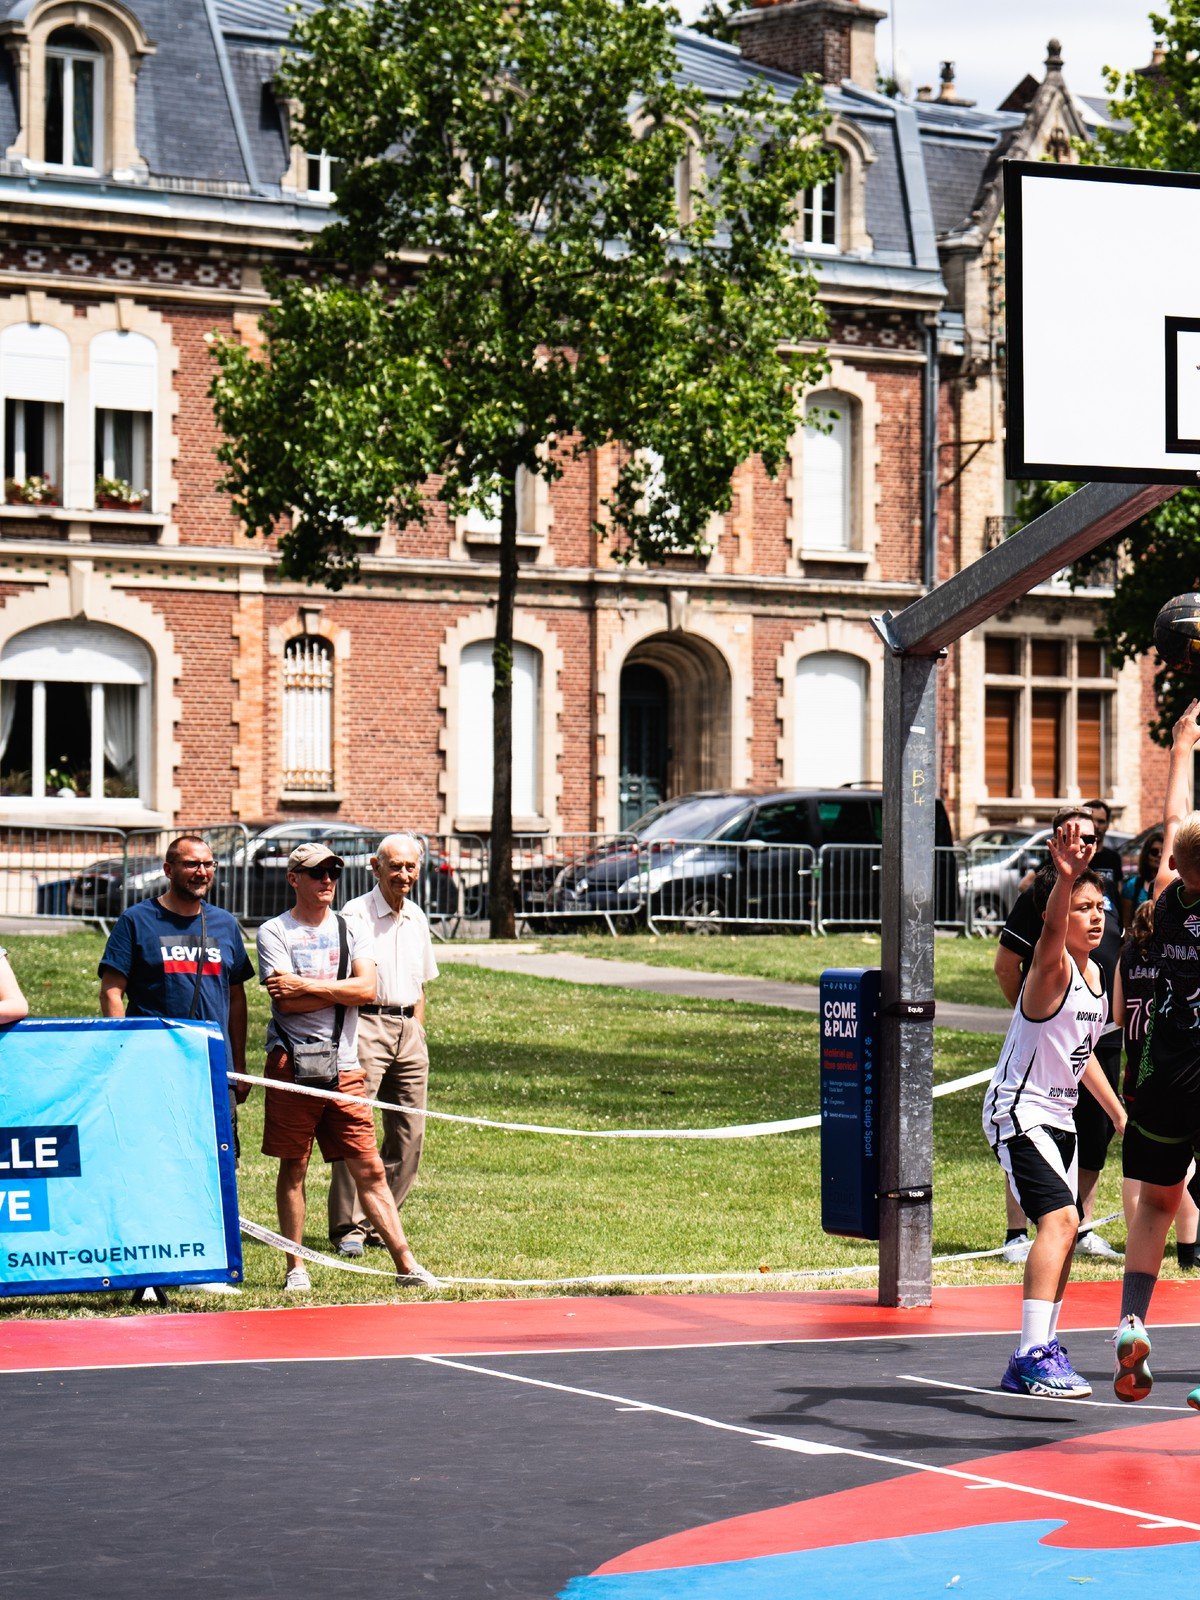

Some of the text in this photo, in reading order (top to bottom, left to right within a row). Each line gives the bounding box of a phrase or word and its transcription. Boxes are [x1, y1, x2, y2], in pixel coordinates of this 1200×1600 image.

[912, 769, 925, 787] B
[823, 1001, 857, 1019] COME
[863, 1098, 874, 1157] Equip Sport
[0, 1190, 32, 1222] E
[7, 1242, 206, 1268] SAINT-QUENTIN.FR
